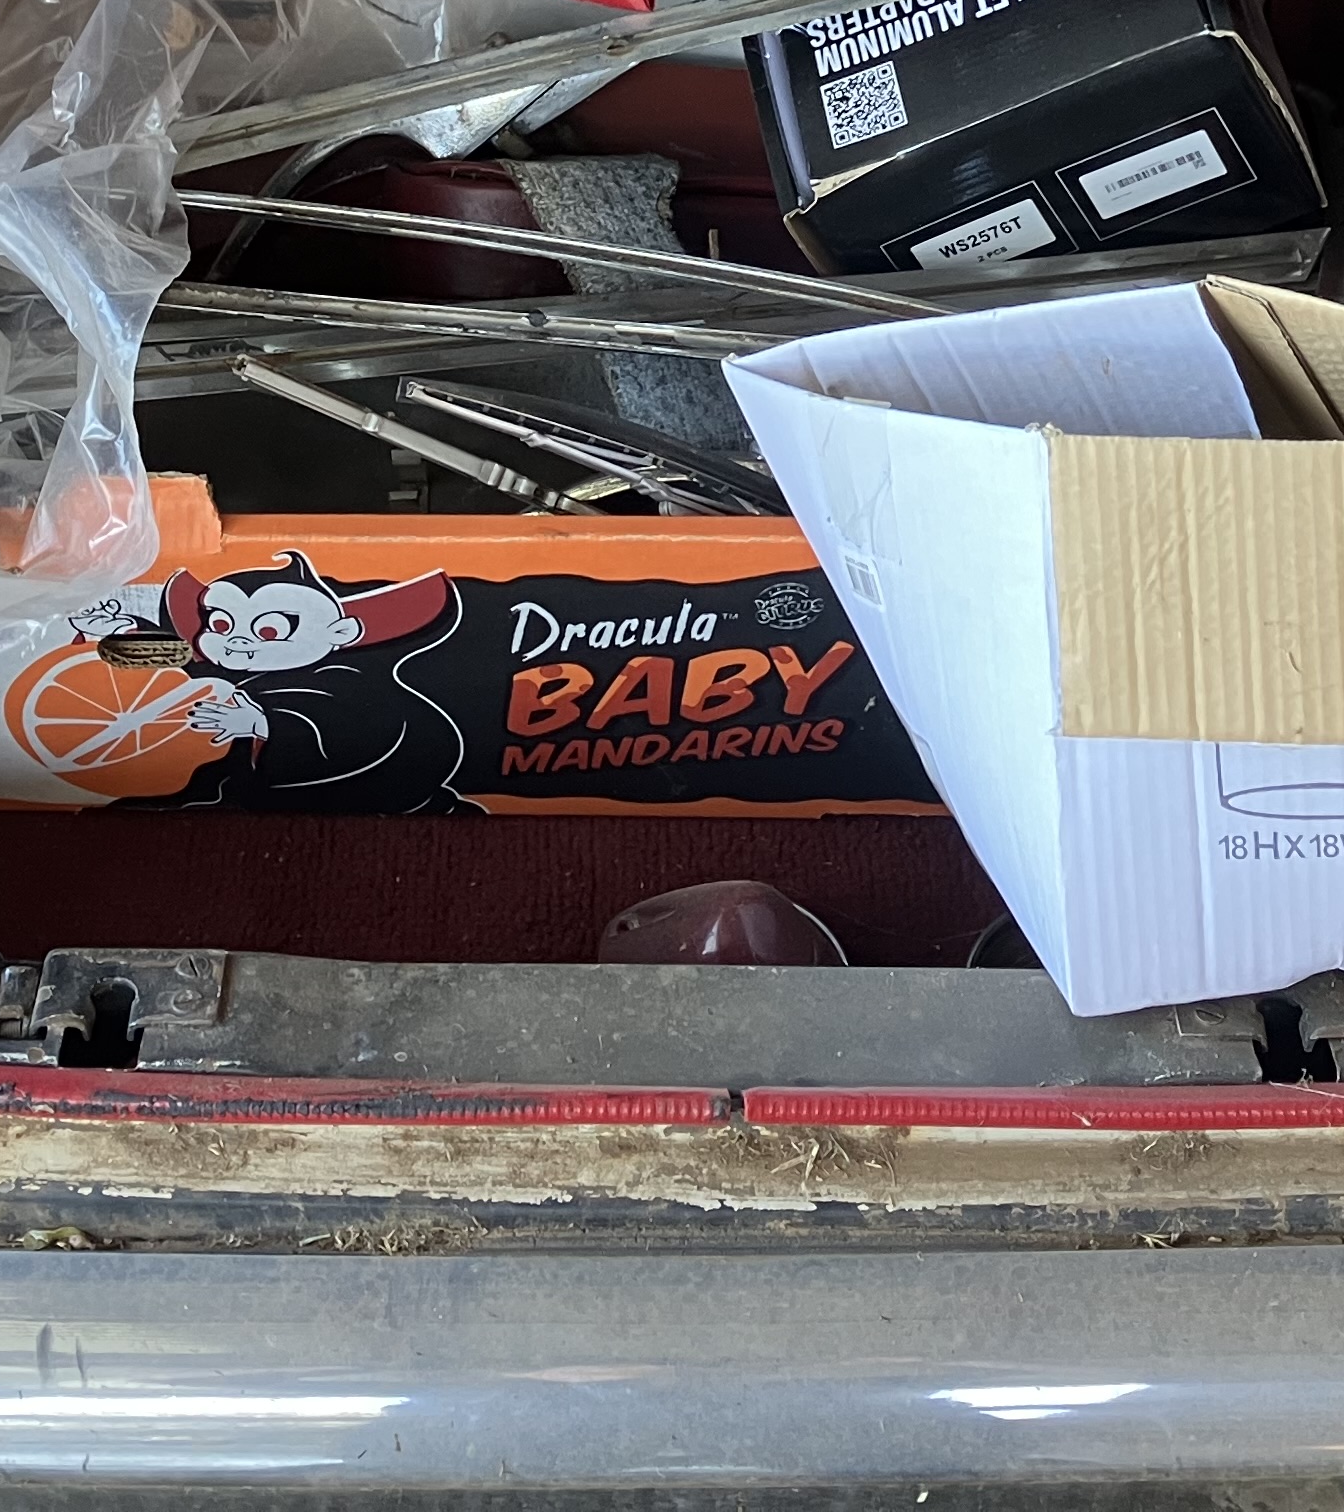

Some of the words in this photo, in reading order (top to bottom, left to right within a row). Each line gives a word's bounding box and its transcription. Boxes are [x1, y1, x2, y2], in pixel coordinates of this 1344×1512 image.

[938, 215, 1022, 259] WS2576T
[977, 255, 985, 263] 2
[986, 246, 1008, 259] PCS
[509, 597, 718, 663] Dracula
[506, 639, 855, 737] BABY
[500, 718, 845, 776] MANDARINS
